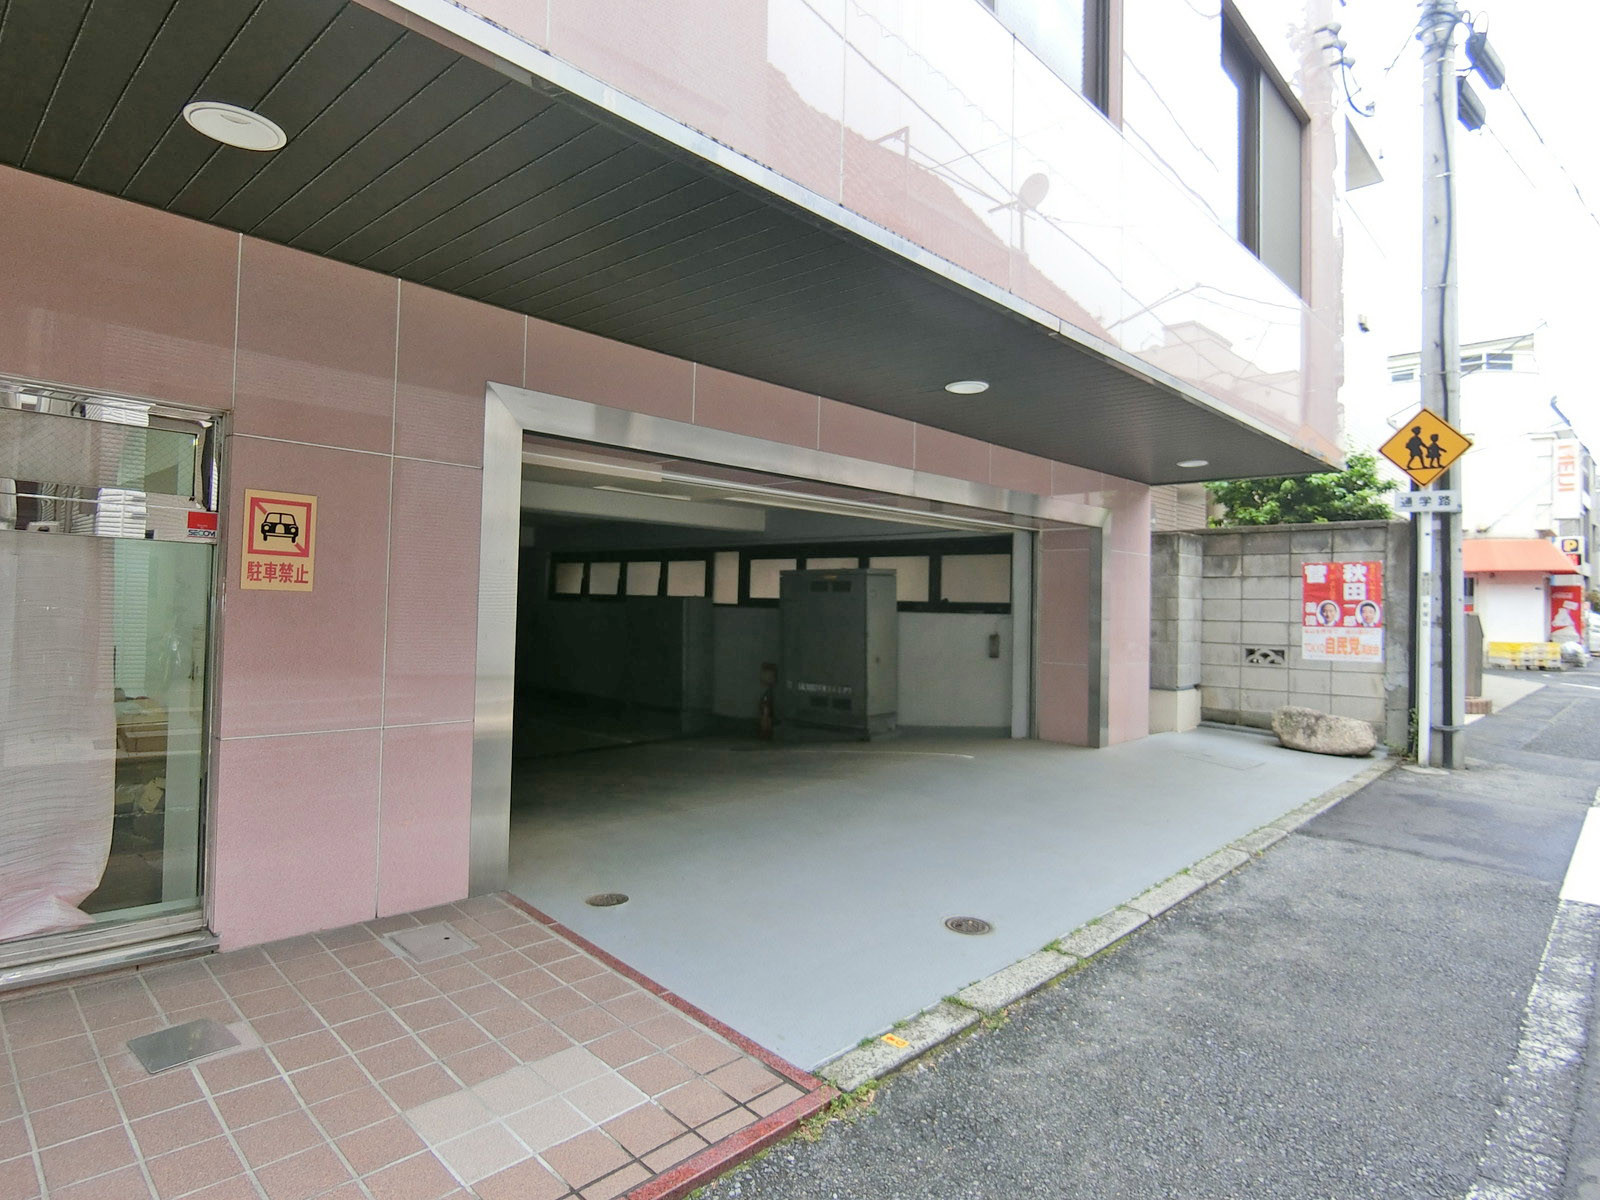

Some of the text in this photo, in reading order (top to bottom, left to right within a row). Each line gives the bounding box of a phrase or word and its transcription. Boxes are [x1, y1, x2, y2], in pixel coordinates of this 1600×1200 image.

[1558, 444, 1576, 493] MEIJI
[1400, 495, 1452, 508] 通学路
[188, 529, 217, 538] SECOM
[246, 560, 309, 584] 駐車禁止
